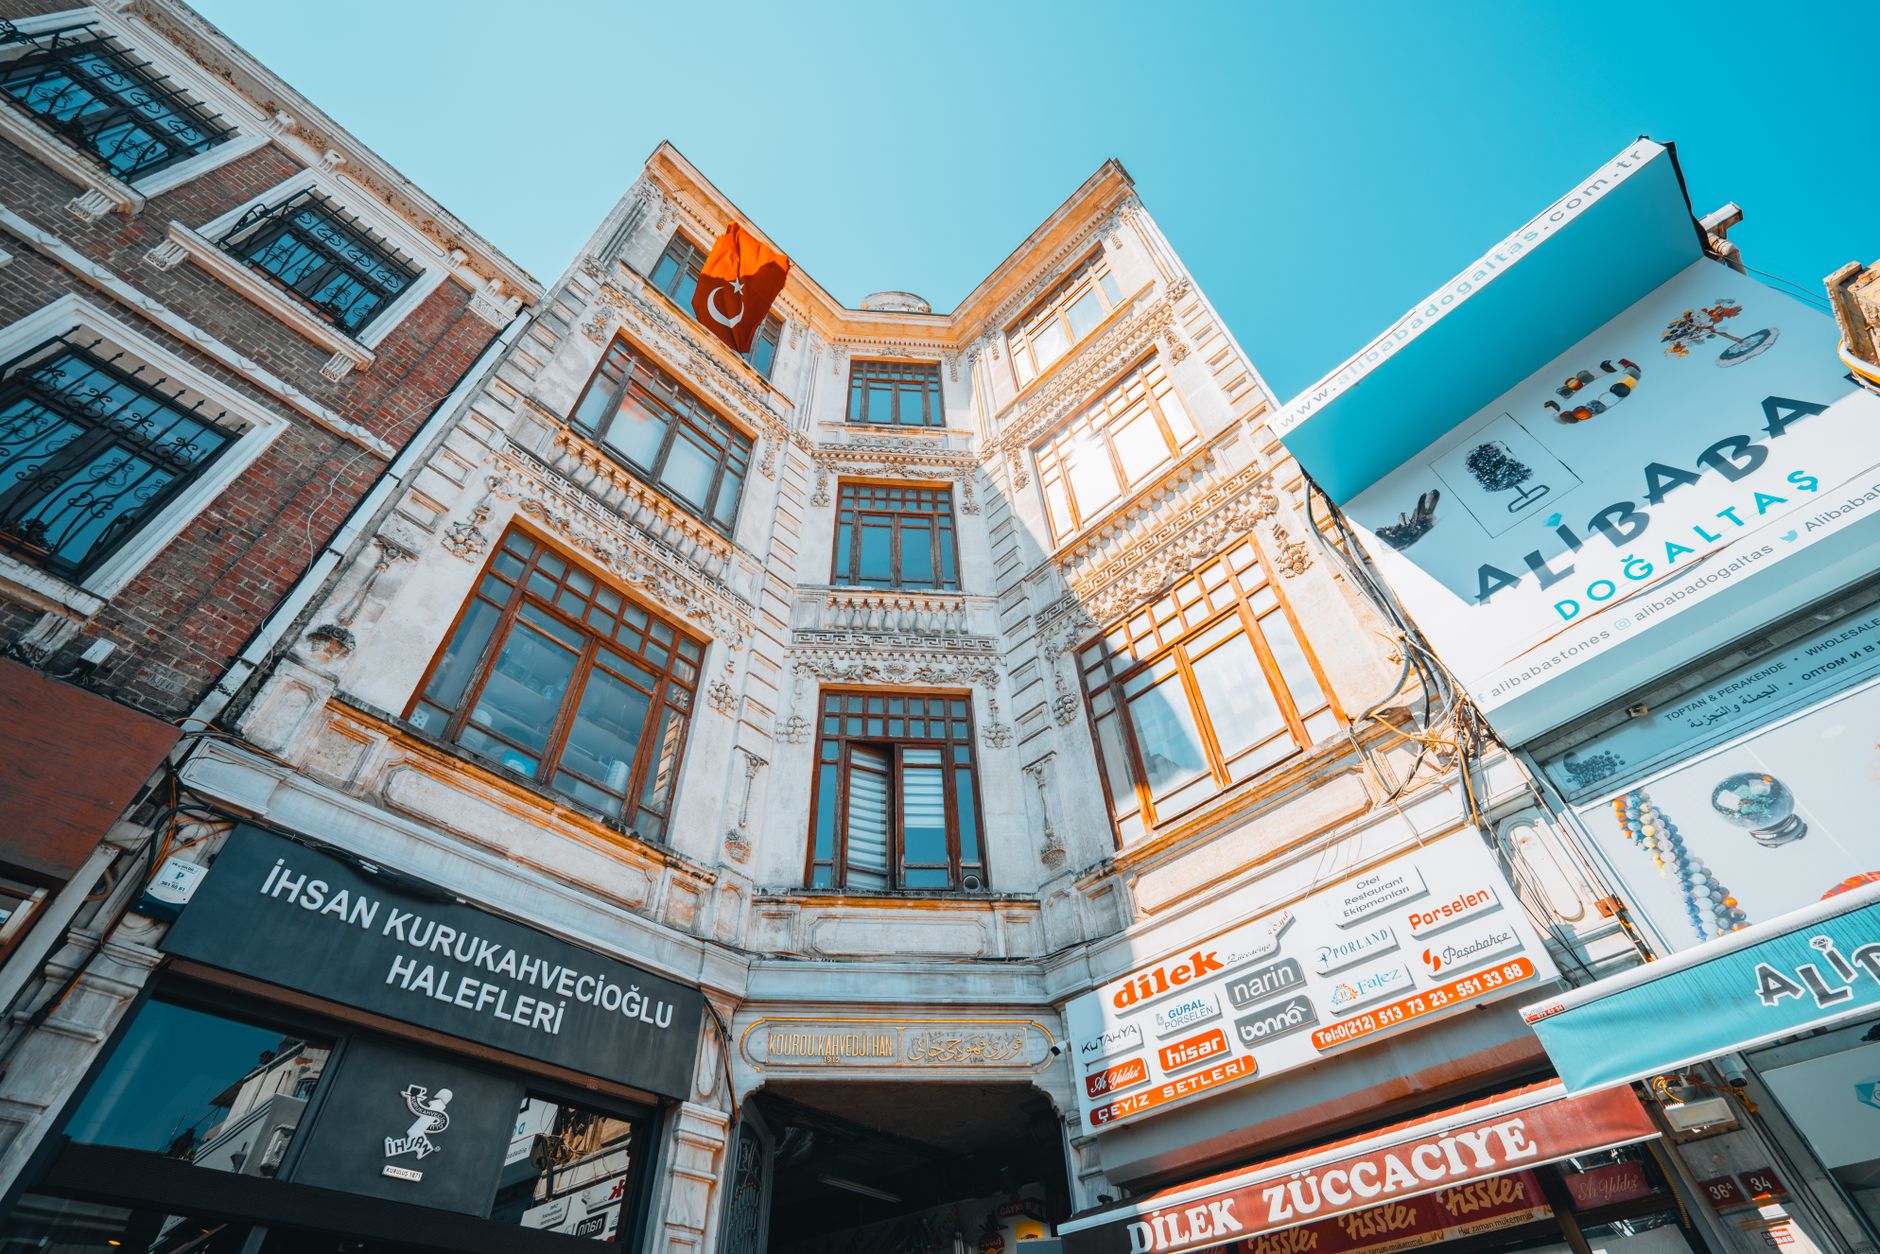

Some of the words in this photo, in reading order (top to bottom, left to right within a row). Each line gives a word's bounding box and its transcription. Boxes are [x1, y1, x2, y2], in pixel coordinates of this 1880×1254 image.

[1280, 149, 1641, 428] www.alibabadogaltas.com.tr
[1474, 395, 1831, 606] ALİBABA
[1554, 470, 1819, 621] DOĞALTAŞ
[1491, 630, 1611, 697] alibabastones
[1633, 543, 1774, 622] alibabadogaltas
[1663, 698, 1707, 721] TOPTAN
[1708, 694, 1718, 702] &
[1717, 662, 1788, 698] PERAKENDE
[1804, 617, 1880, 656] WHOLESALE
[1343, 876, 1405, 906] Restaurant
[1343, 886, 1410, 918] Ekipmanları
[1356, 875, 1381, 890] Otel
[1407, 889, 1490, 931] Porselen
[260, 858, 380, 930] İHSAN
[382, 908, 674, 1029] KURUKAHVECİOĞLU
[1332, 928, 1389, 958] PORLAND
[1442, 931, 1512, 966] Paşabahçe
[385, 955, 566, 1035] HALEFLERİ
[1113, 951, 1225, 1009] dilek
[1233, 965, 1295, 1003] narin
[1378, 1005, 1404, 1025] 513
[1407, 998, 1425, 1015] 73
[1455, 977, 1483, 998] 551
[1484, 969, 1503, 988] 33
[1504, 963, 1524, 981] 88
[1164, 1005, 1215, 1031] PORSELEN
[1168, 999, 1206, 1019] GÜRAL
[1166, 1035, 1221, 1068] hisar
[1097, 1093, 1150, 1123] ÇEYİZ
[1162, 1057, 1247, 1099] SETLERİ
[385, 1135, 433, 1157] İHSAN
[1126, 1197, 1243, 1254] DİLEK
[1262, 1117, 1538, 1224] ZÜCCACİYE
[1750, 1174, 1773, 1193] 34
